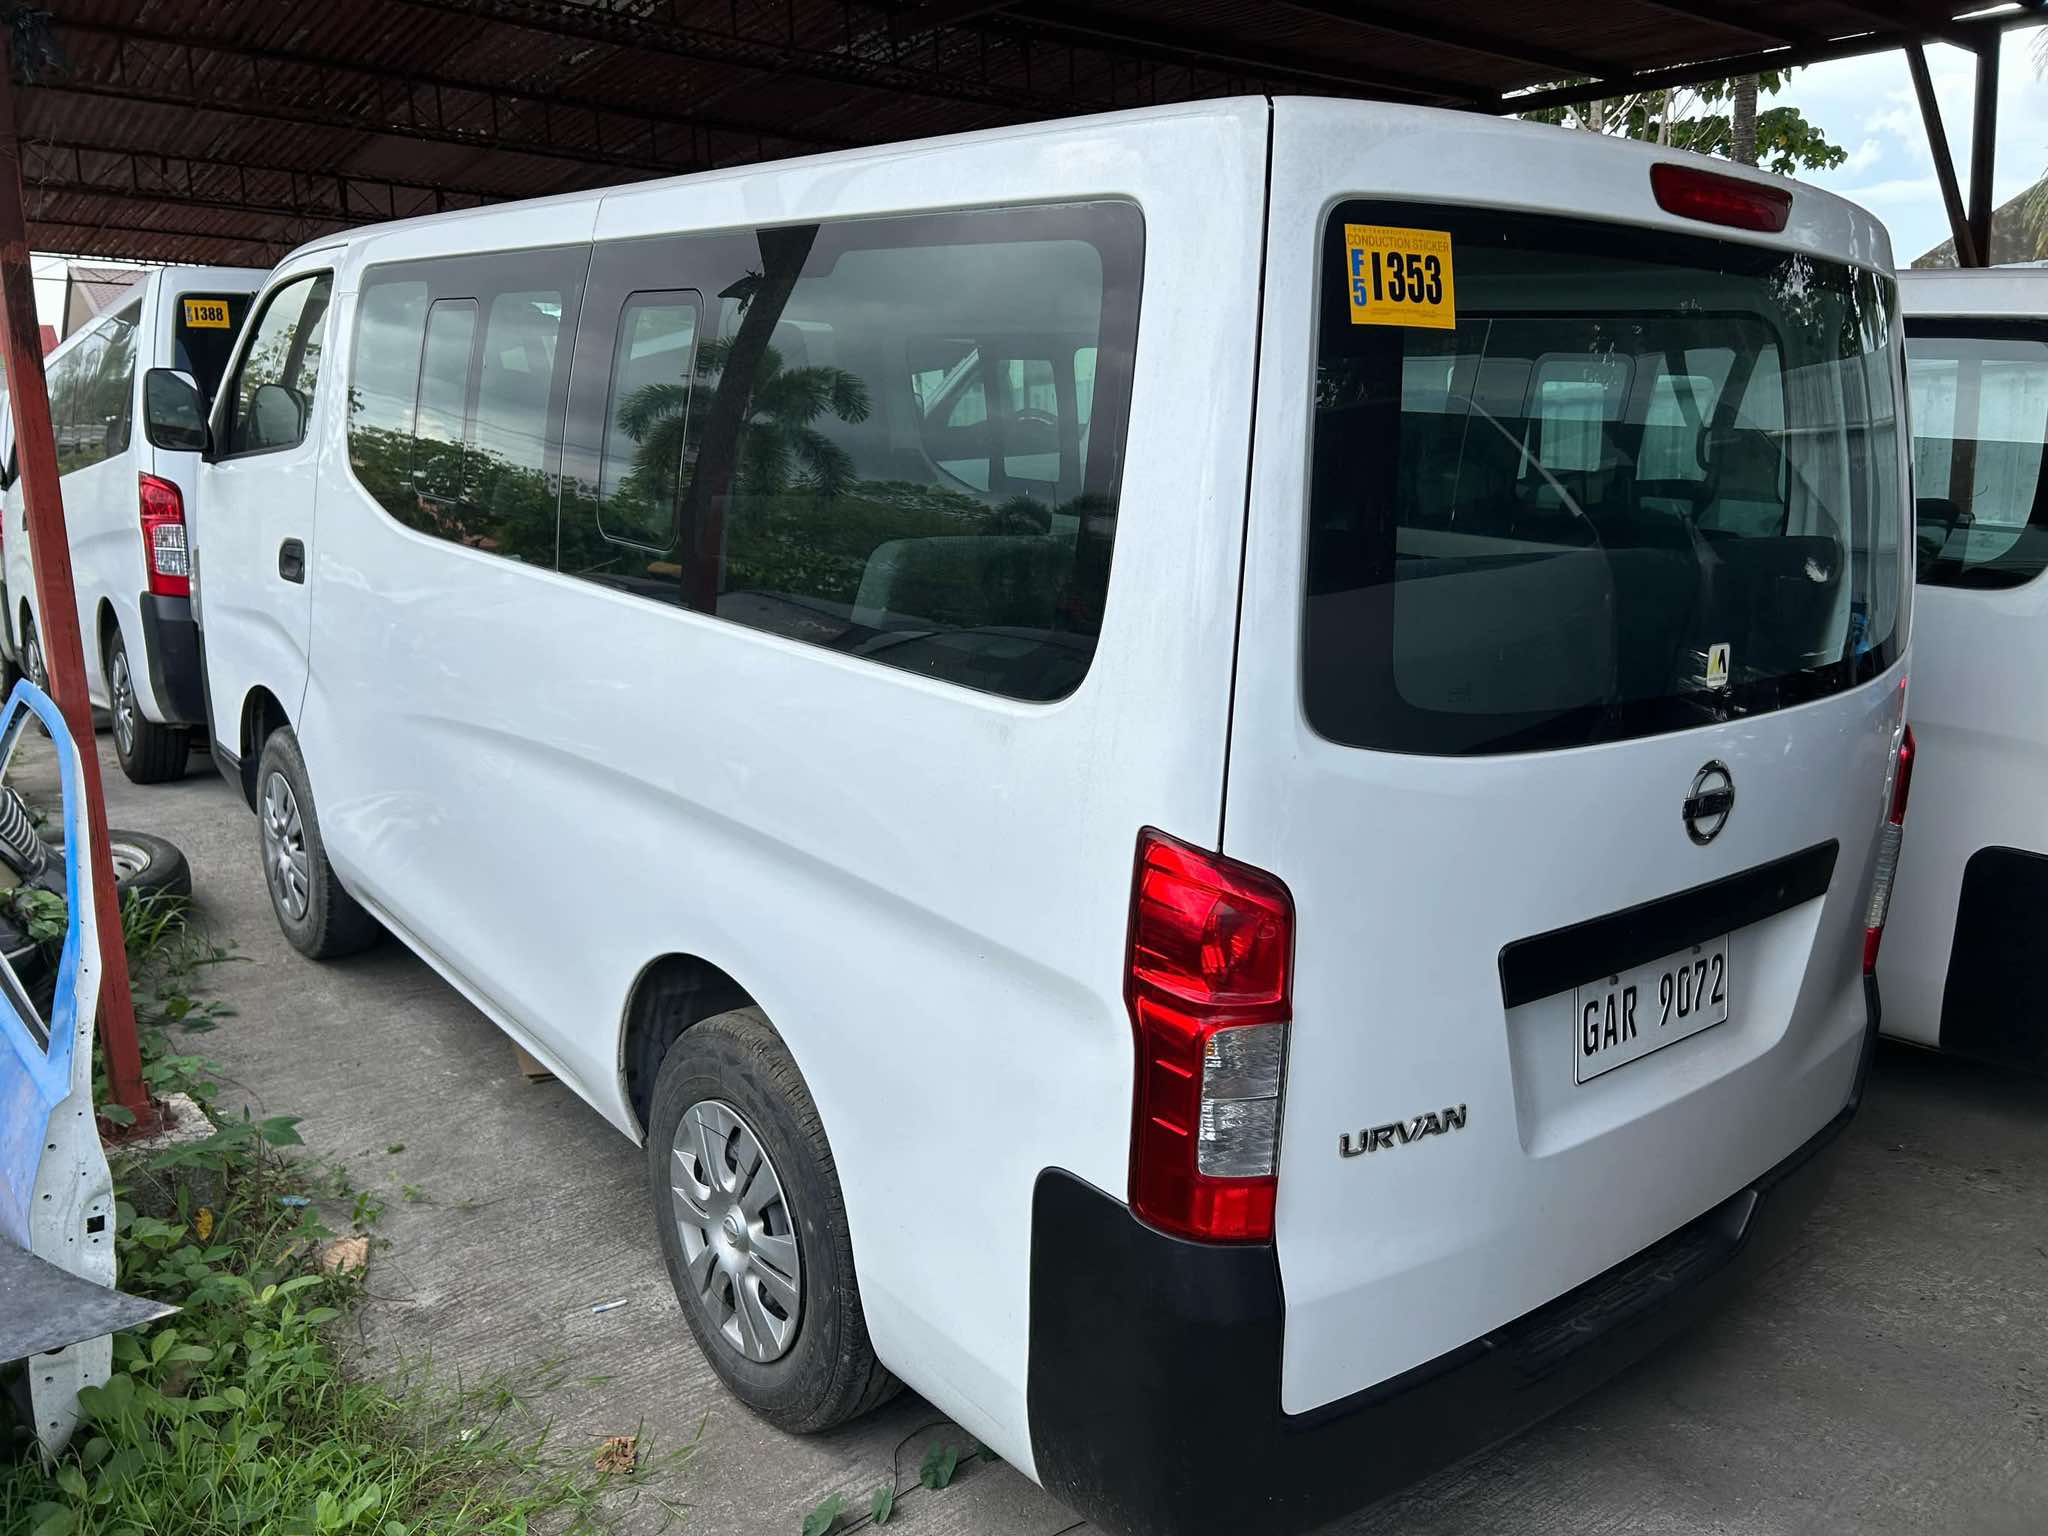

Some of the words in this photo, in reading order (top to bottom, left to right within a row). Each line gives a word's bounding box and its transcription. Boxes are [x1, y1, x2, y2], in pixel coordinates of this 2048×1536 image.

[1347, 233, 1411, 249] CONDUCTION
[1412, 238, 1449, 252] STICKER
[1581, 985, 1637, 1056] GAR
[1658, 953, 1723, 1027] 9072
[1339, 1103, 1467, 1159] URVAN
